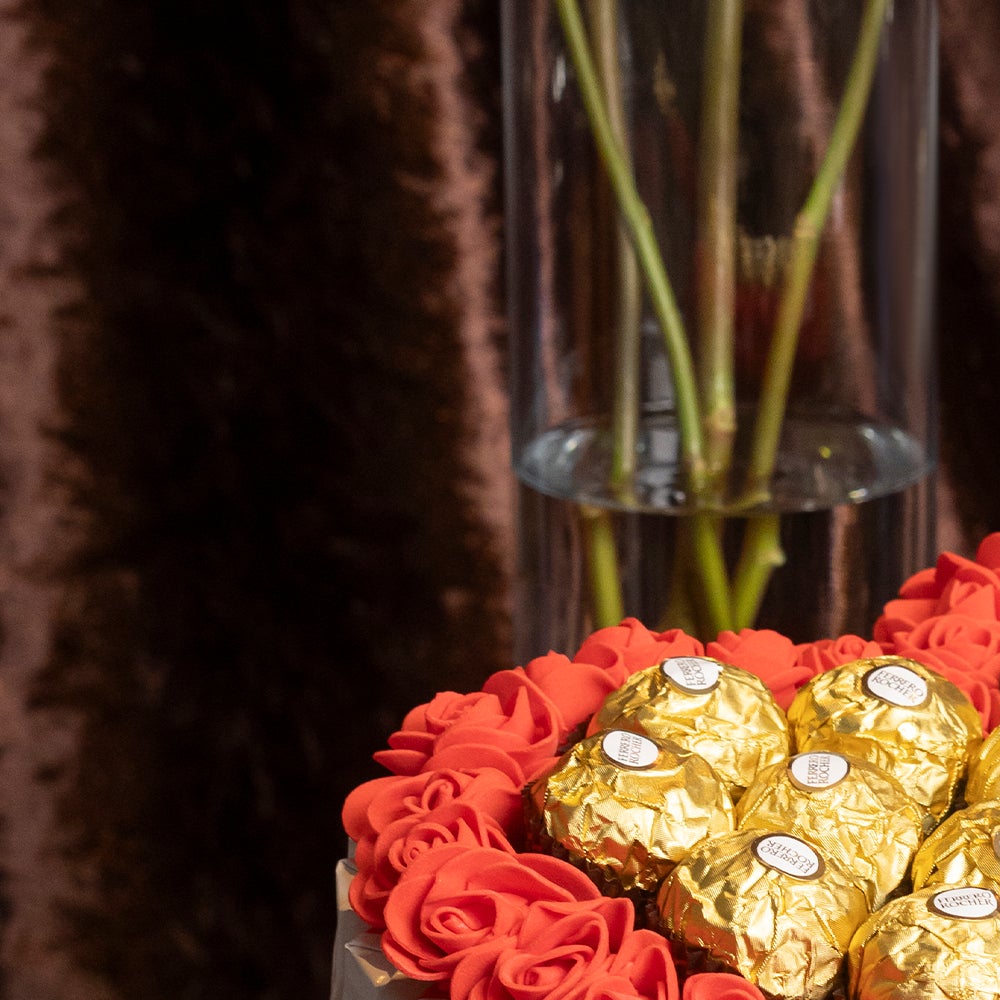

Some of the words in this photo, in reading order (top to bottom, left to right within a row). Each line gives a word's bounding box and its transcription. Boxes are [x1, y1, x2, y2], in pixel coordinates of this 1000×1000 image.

[872, 677, 918, 703] ROCHER
[878, 670, 924, 696] FERRERO
[618, 733, 631, 762] FERRERO
[629, 736, 642, 764] ROCHER
[808, 755, 818, 784] FERRERO
[819, 756, 830, 784] ROCHER
[761, 846, 810, 874] FERRERO
[767, 840, 815, 868] ROCHER
[938, 892, 991, 903] FERRERO
[940, 898, 993, 908] ROCHER
